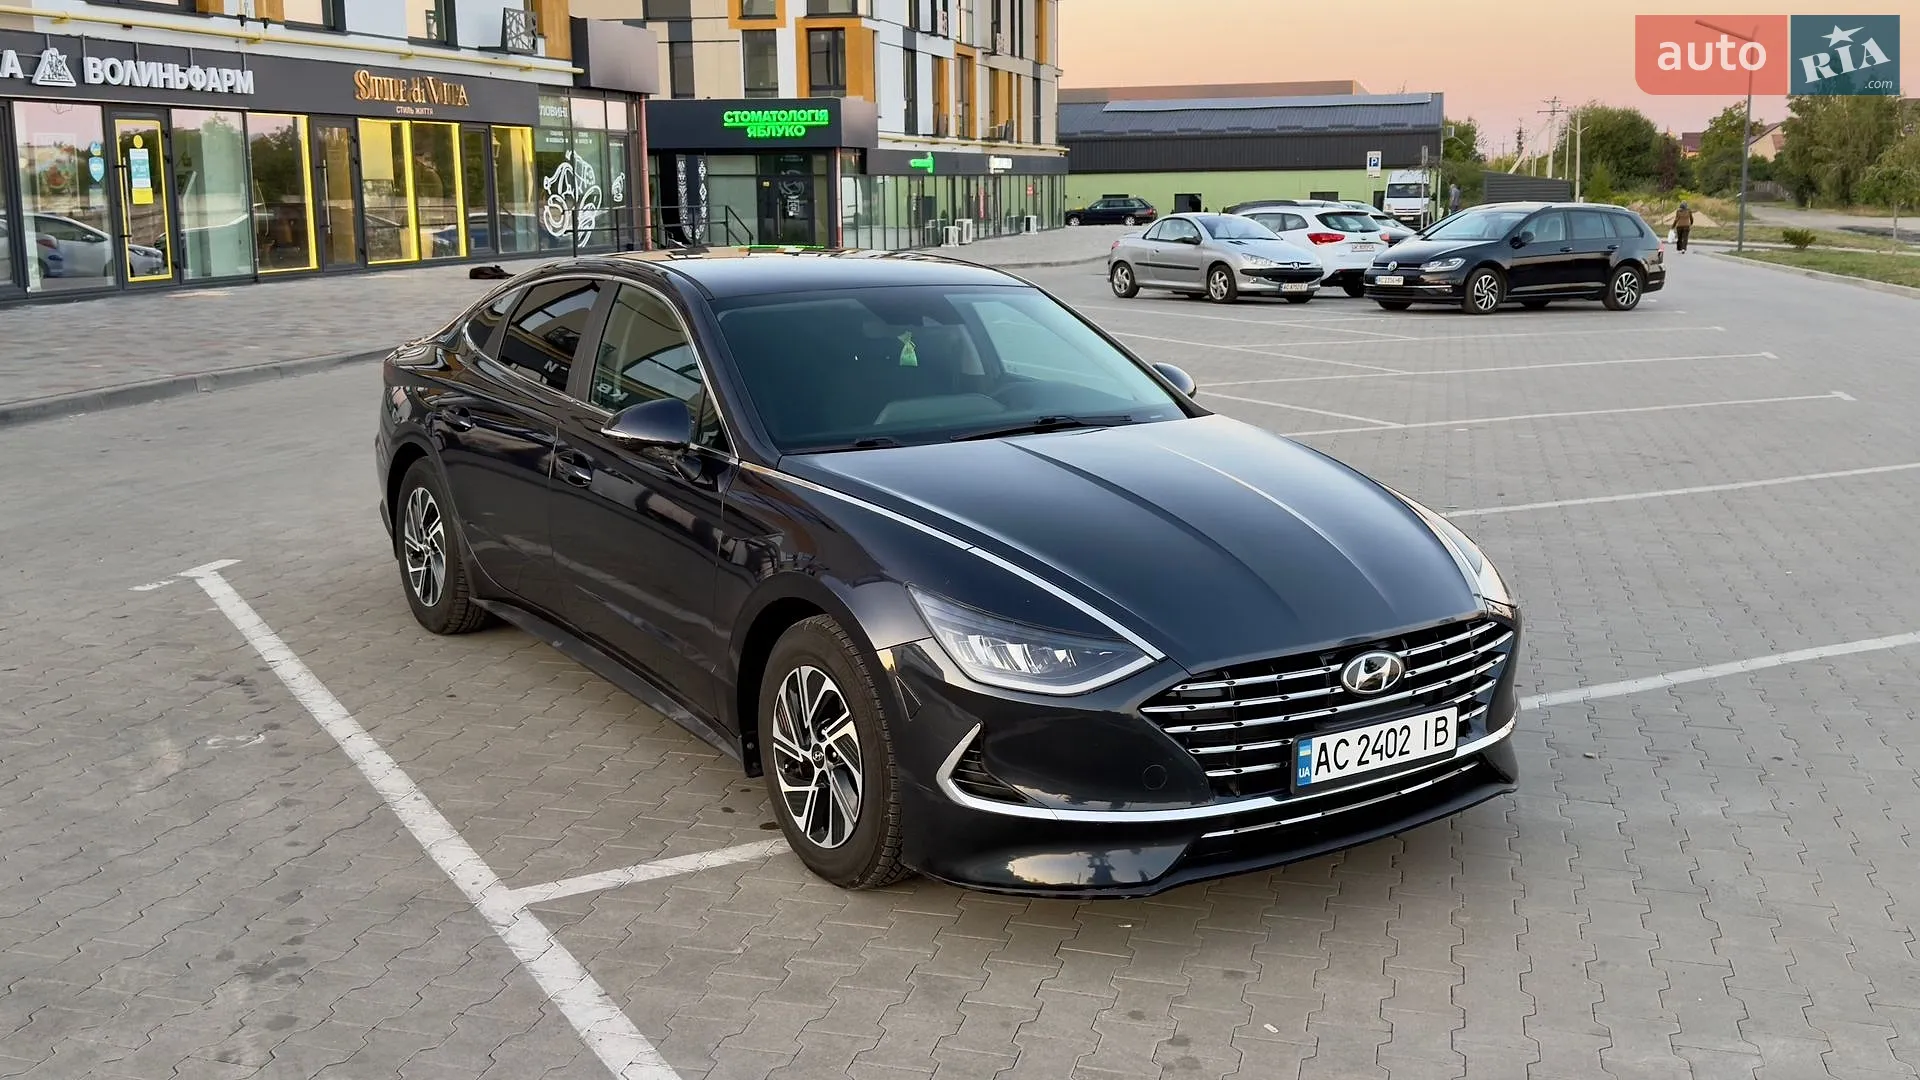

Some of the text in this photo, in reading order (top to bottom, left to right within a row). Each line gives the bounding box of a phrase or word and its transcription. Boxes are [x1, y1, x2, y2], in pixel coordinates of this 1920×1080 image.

[0, 49, 255, 95] А ВОЛИНЬФАРМ
[723, 109, 829, 123] СТОМАТОЛОГІЯ
[746, 125, 806, 138] ЯБЛУКО
[1315, 715, 1449, 776] AC 2402 IB
[1298, 766, 1311, 778] UA
